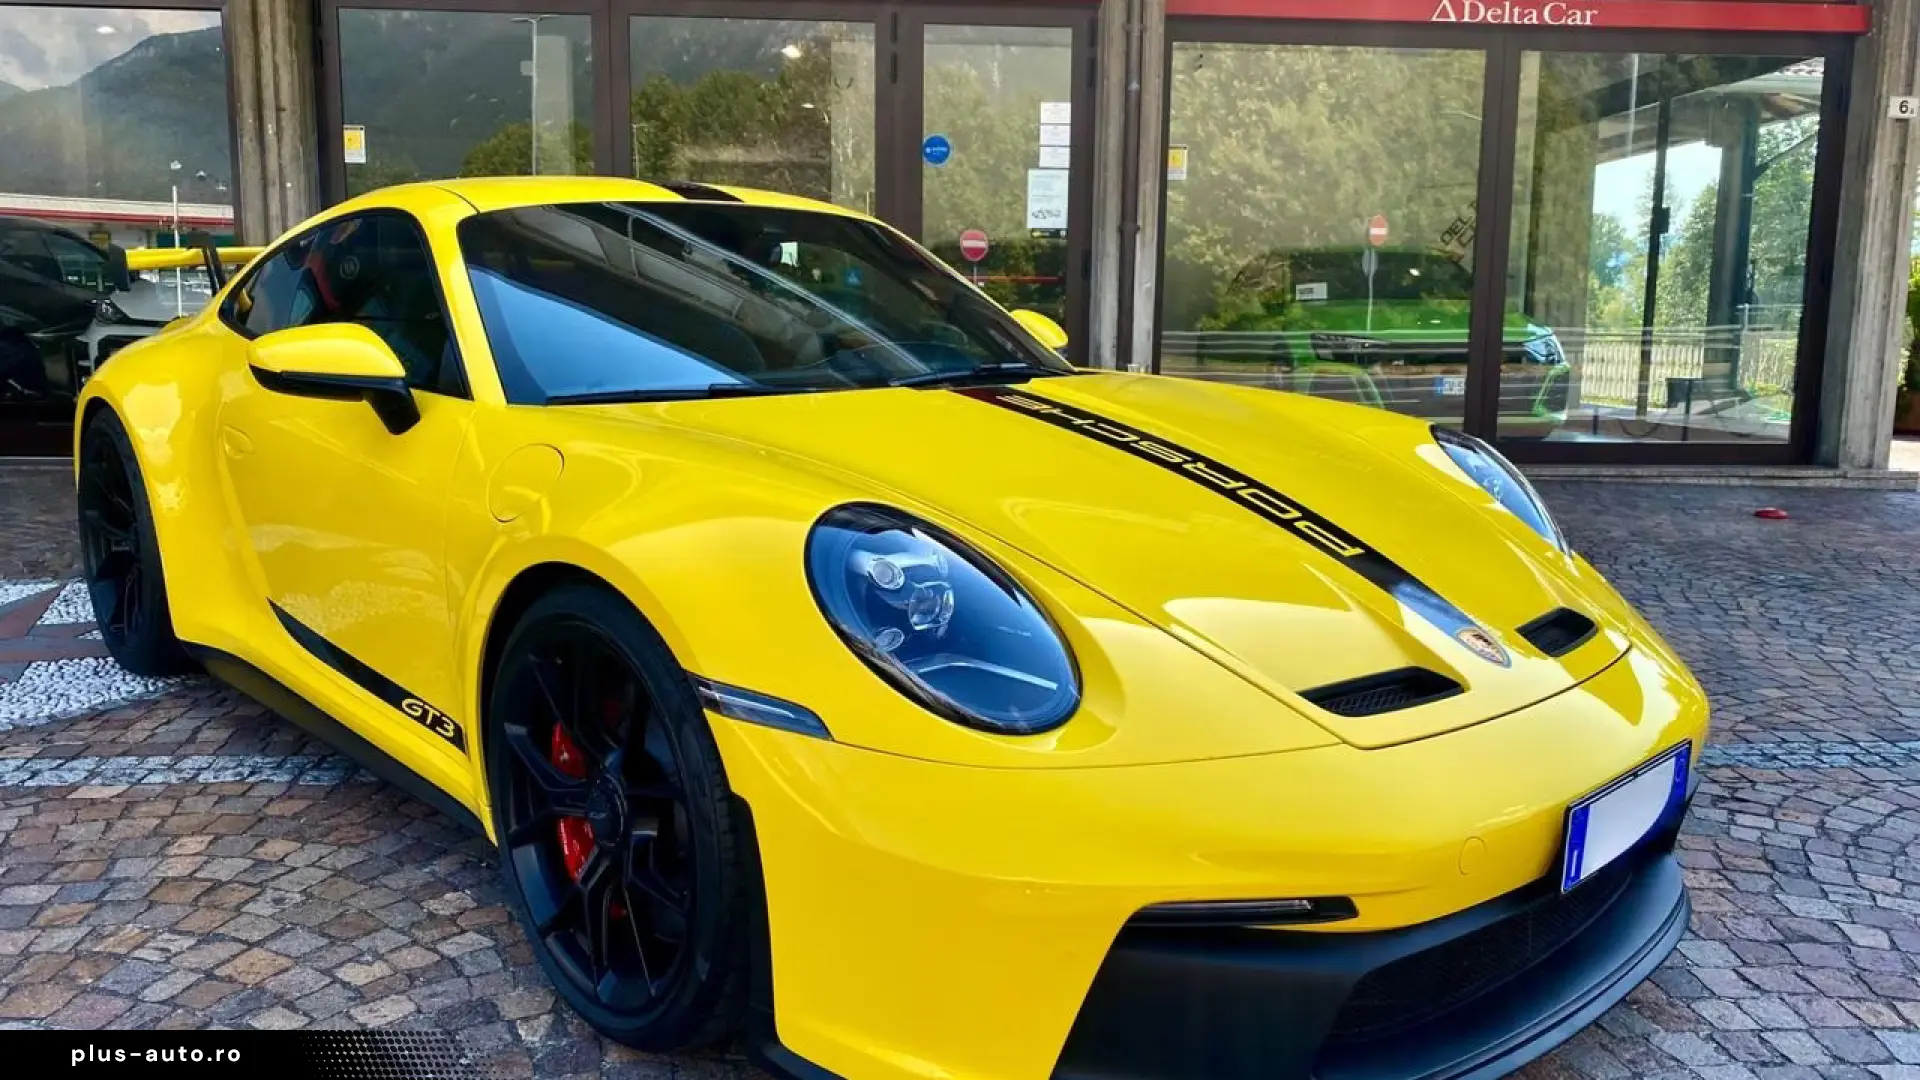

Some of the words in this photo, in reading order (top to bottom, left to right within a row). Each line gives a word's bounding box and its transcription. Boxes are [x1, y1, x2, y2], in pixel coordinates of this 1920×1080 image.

[1461, 0, 1539, 24] Delta
[1542, 2, 1599, 25] Car
[995, 394, 1365, 557] PORSCHE
[401, 698, 455, 738] GT3
